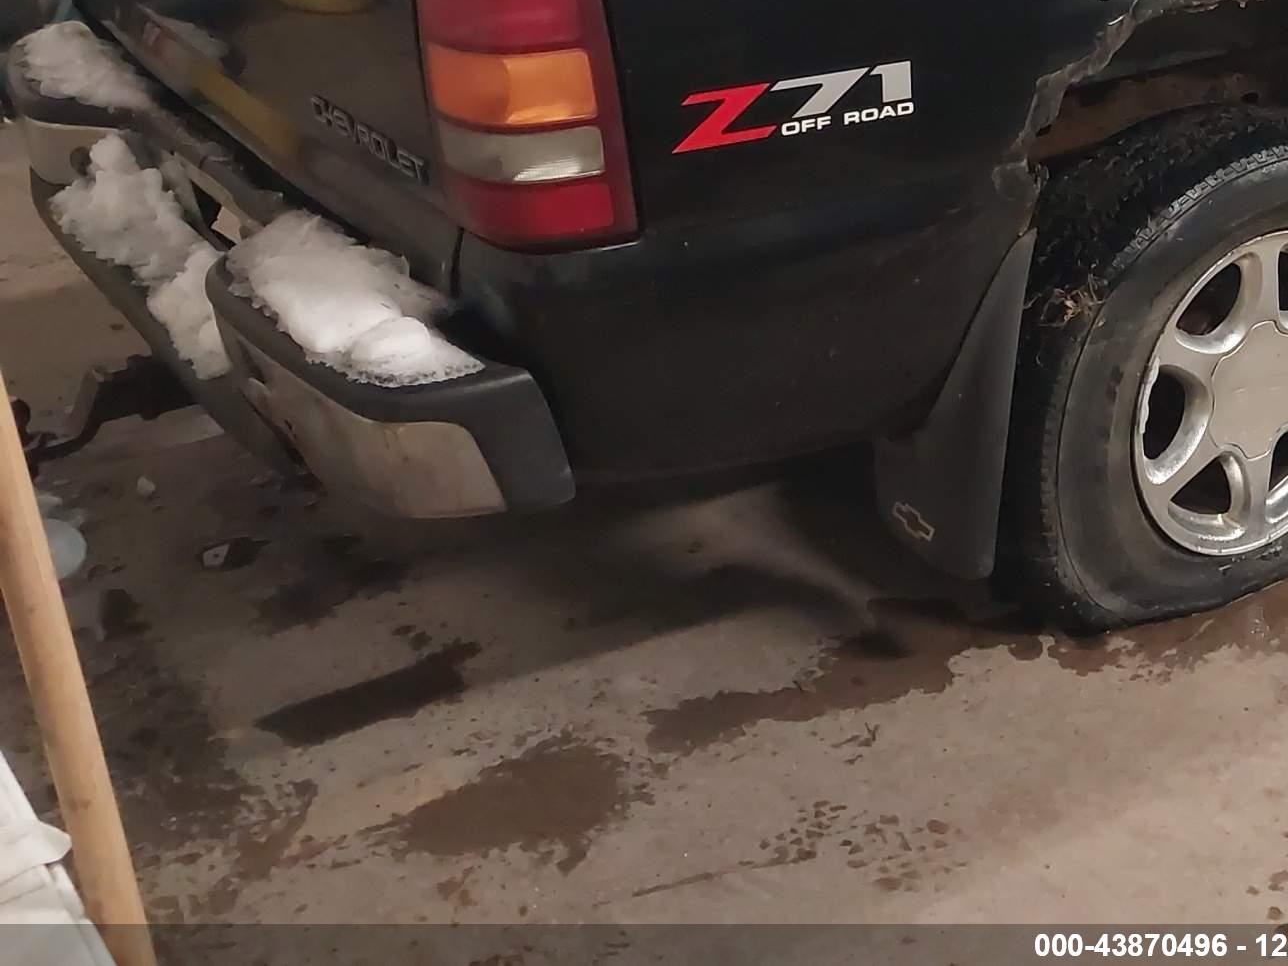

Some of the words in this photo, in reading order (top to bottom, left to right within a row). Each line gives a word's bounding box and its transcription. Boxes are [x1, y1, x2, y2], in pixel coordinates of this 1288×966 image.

[310, 95, 424, 179] CHEVROLET
[671, 60, 913, 154] Z71
[781, 115, 832, 136] OFF
[843, 102, 914, 126] ROAD
